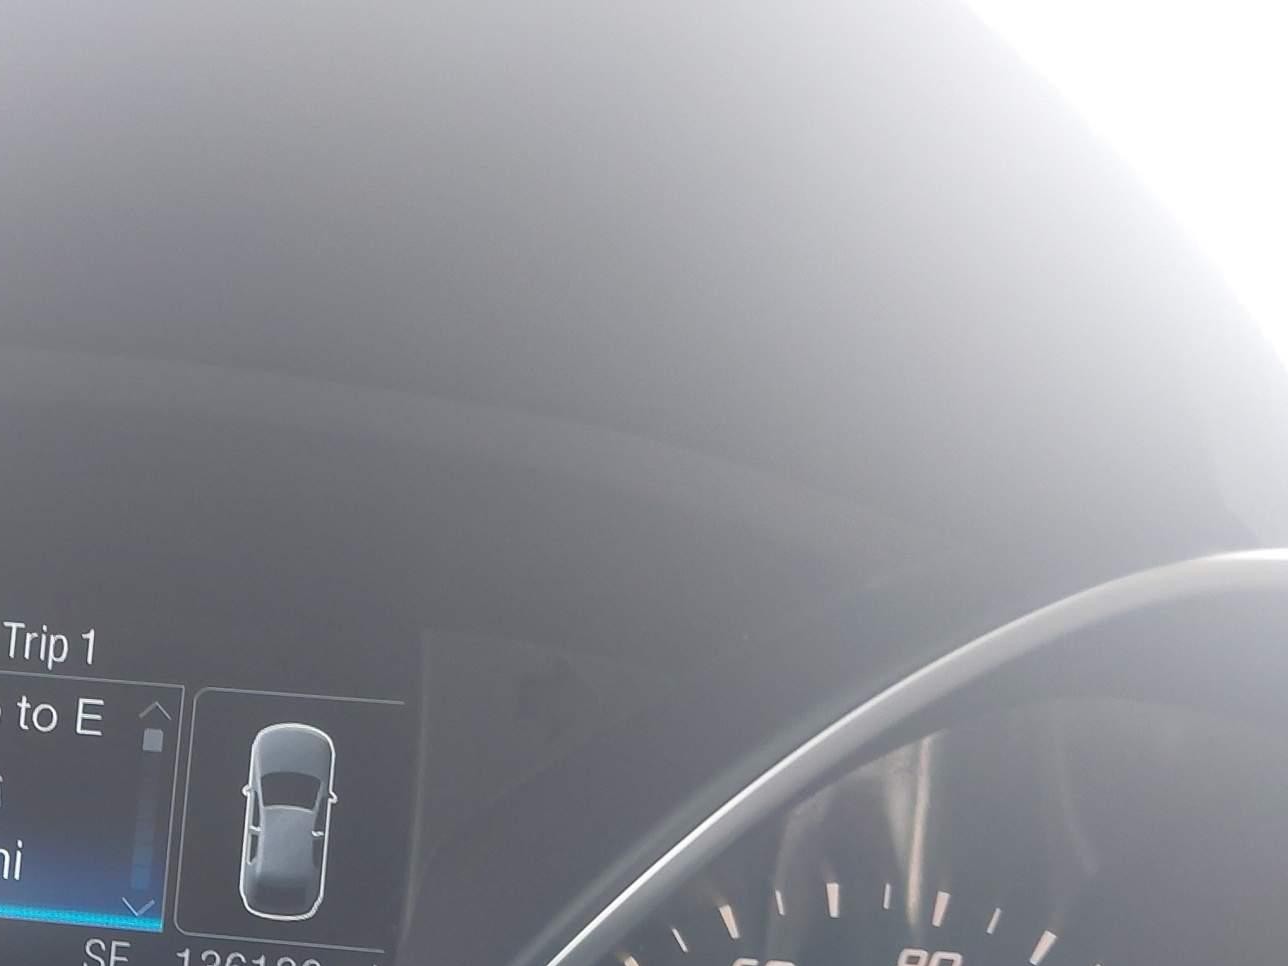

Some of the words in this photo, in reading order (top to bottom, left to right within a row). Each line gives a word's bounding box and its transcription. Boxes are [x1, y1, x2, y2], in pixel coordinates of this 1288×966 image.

[3, 621, 69, 668] Trip
[80, 628, 96, 664] 1
[17, 690, 59, 734] to
[76, 699, 105, 736] E
